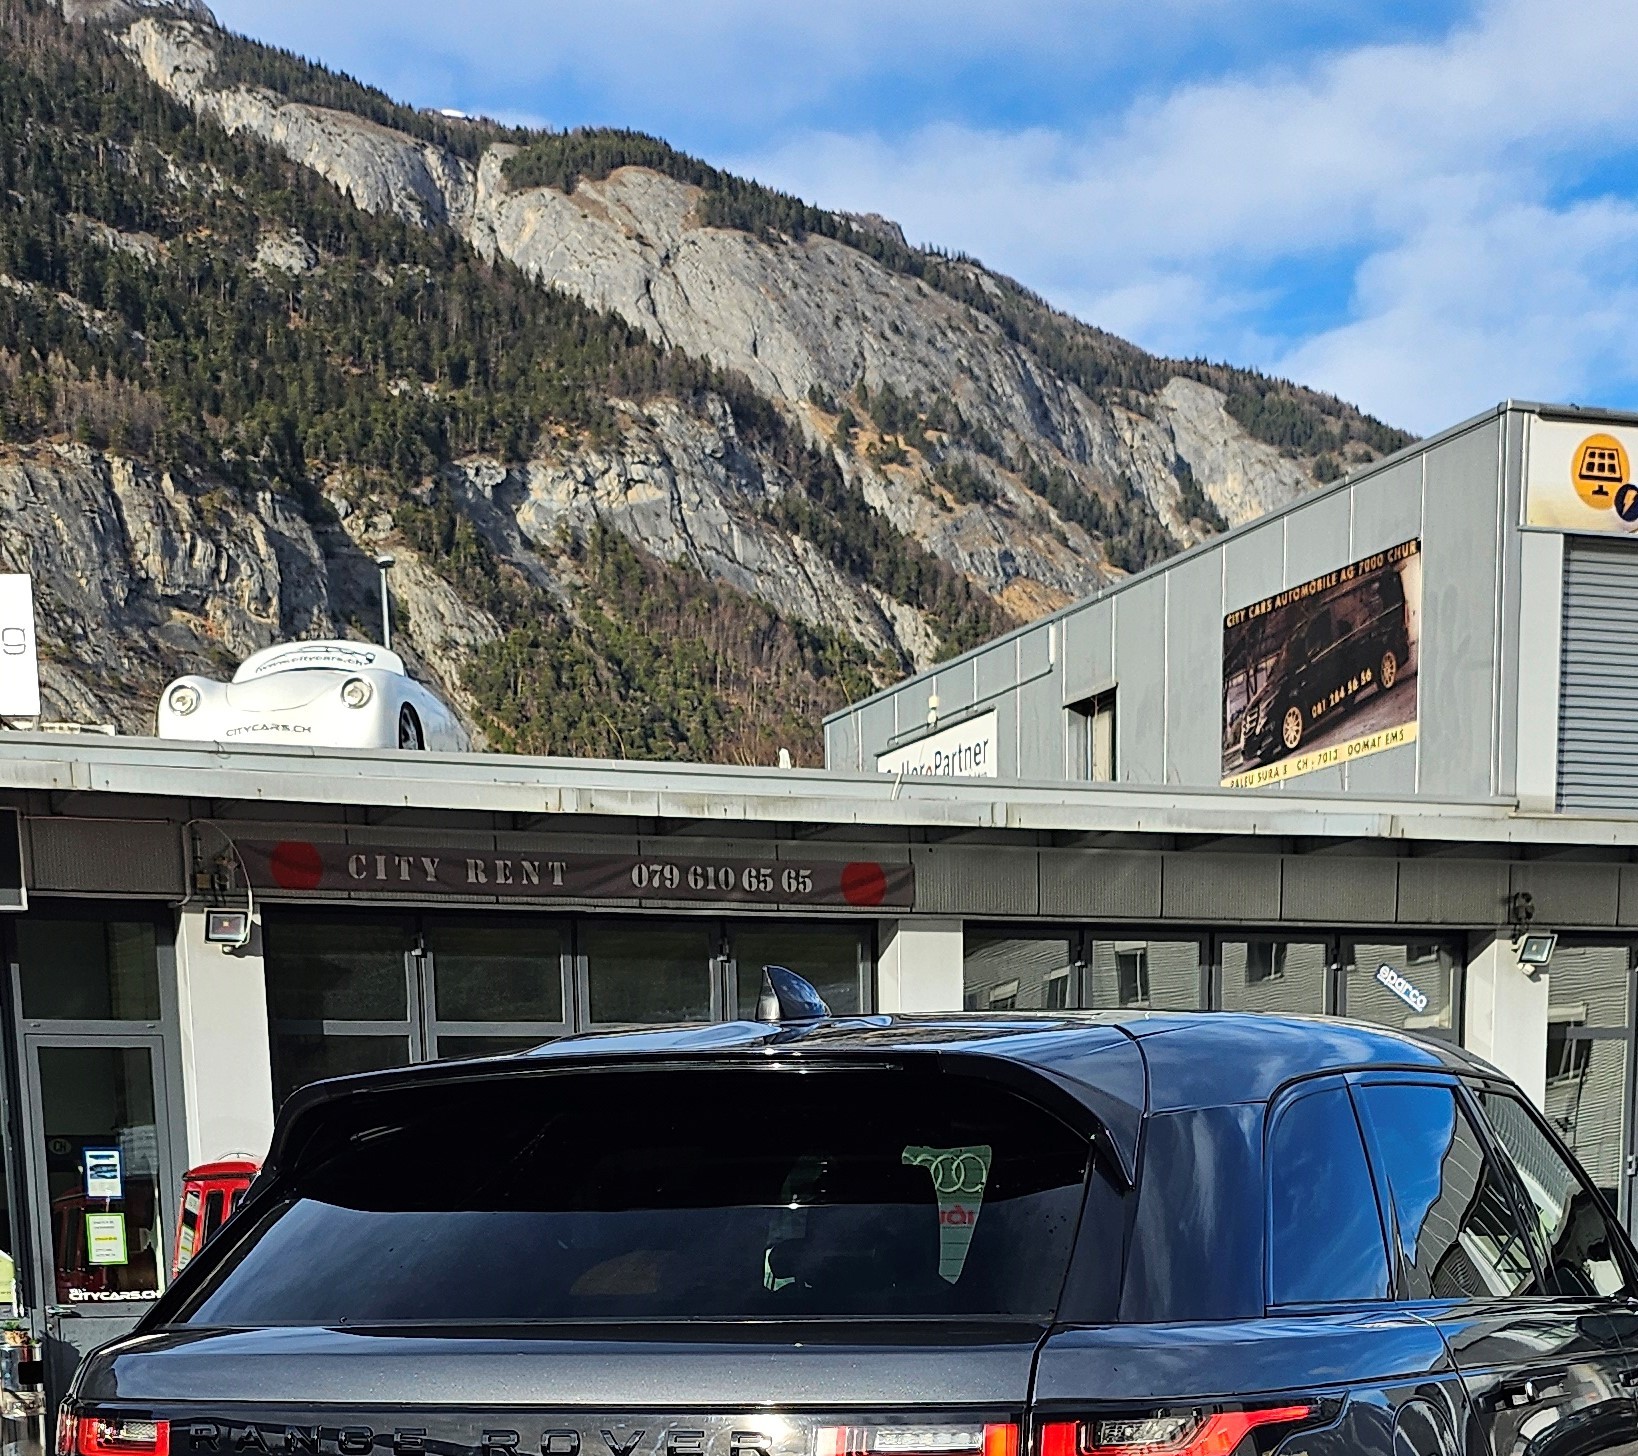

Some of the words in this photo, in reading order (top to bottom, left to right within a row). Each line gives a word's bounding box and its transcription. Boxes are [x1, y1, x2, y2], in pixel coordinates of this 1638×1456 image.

[1249, 599, 1272, 619] CARS
[348, 854, 440, 882] CITY
[466, 858, 567, 886] RENT
[631, 863, 680, 889] 079
[687, 865, 735, 891] 610
[741, 867, 774, 892] 65
[781, 868, 813, 893] 65
